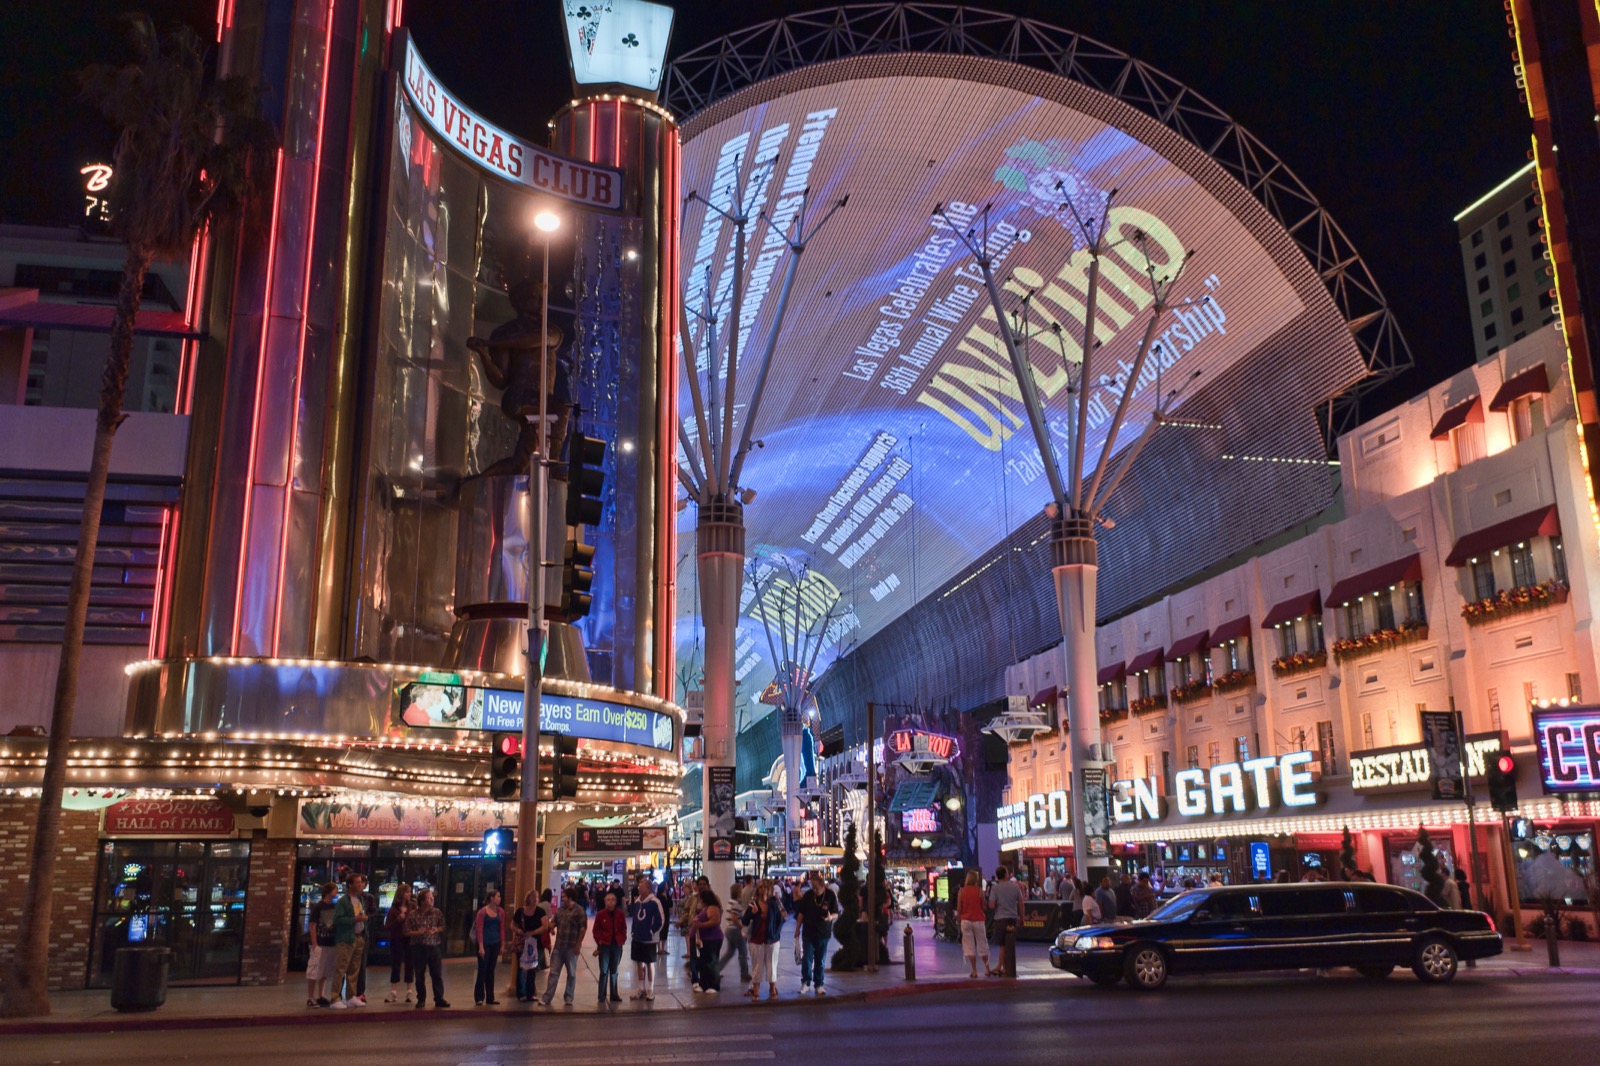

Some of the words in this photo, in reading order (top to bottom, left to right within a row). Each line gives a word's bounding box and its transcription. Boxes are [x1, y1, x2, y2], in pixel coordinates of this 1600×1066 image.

[408, 48, 436, 118] LAS
[442, 94, 523, 178] VEGAS
[533, 153, 612, 205] CLUB
[754, 122, 790, 166] the
[780, 107, 838, 196] Fremont
[80, 164, 113, 191] B
[761, 195, 805, 251] Street
[931, 201, 978, 232] the
[738, 249, 785, 330] Experience
[880, 235, 957, 319] Celebrates
[926, 284, 979, 324] Wine
[855, 320, 903, 359] Vegas
[899, 318, 953, 370] Annual
[843, 359, 878, 382] Las
[880, 366, 920, 396] 36th
[801, 518, 829, 545] Fremont
[860, 432, 898, 472] supports
[868, 474, 897, 504] please
[887, 455, 912, 480] visit
[487, 715, 495, 726] In
[497, 715, 515, 727] Free
[545, 720, 571, 733] Comps.
[488, 695, 522, 715] New
[539, 702, 572, 721] ayers
[575, 703, 600, 723] Earn
[603, 707, 624, 727] Over
[626, 708, 647, 731] $250
[896, 732, 911, 751] LA
[1350, 738, 1500, 789] RESTAUN
[132, 802, 211, 815] SPORTS
[1029, 774, 1160, 830] GOEN
[1175, 751, 1317, 817] GATE
[116, 818, 157, 829] HALL
[160, 817, 177, 829] of
[181, 818, 224, 829] FAME
[330, 812, 399, 831] Welcome
[403, 816, 421, 831] to
[425, 816, 446, 831] the
[451, 817, 490, 834] Vegas
[909, 821, 937, 831] NEXT
[997, 815, 1027, 839] CASINO
